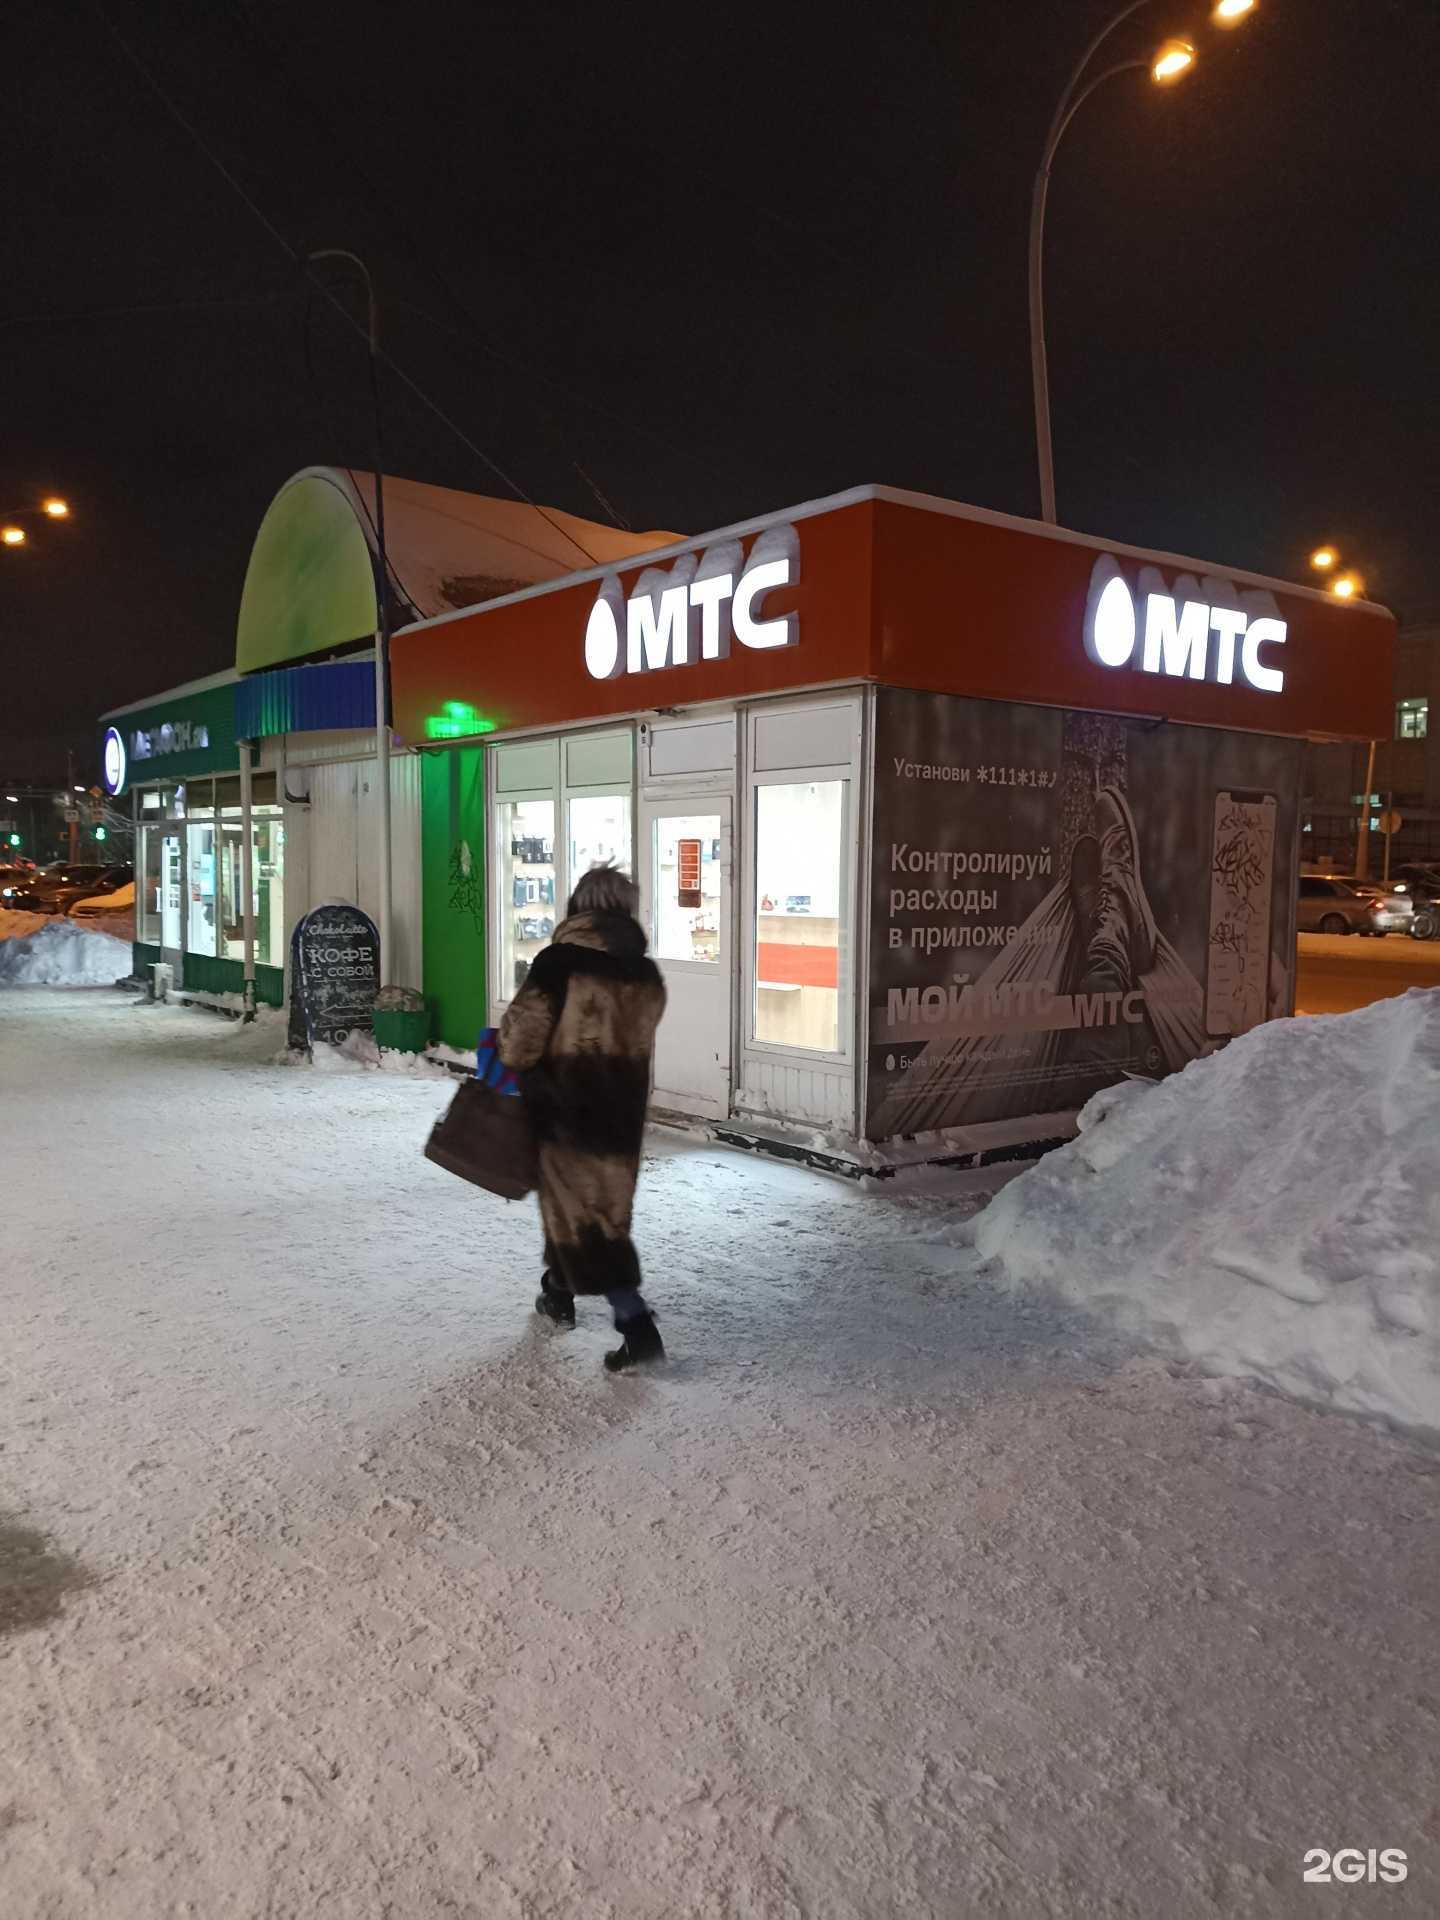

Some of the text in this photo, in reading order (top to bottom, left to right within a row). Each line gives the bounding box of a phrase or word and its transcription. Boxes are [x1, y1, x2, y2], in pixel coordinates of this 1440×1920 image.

[626, 558, 789, 674] МТС
[1143, 593, 1287, 693] МТС
[893, 757, 970, 782] Установи
[891, 843, 1051, 881] Контролируй
[889, 888, 998, 918] расходы
[888, 926, 903, 949] в
[310, 947, 373, 963] КОФЕ
[887, 973, 975, 1026] МОЙ
